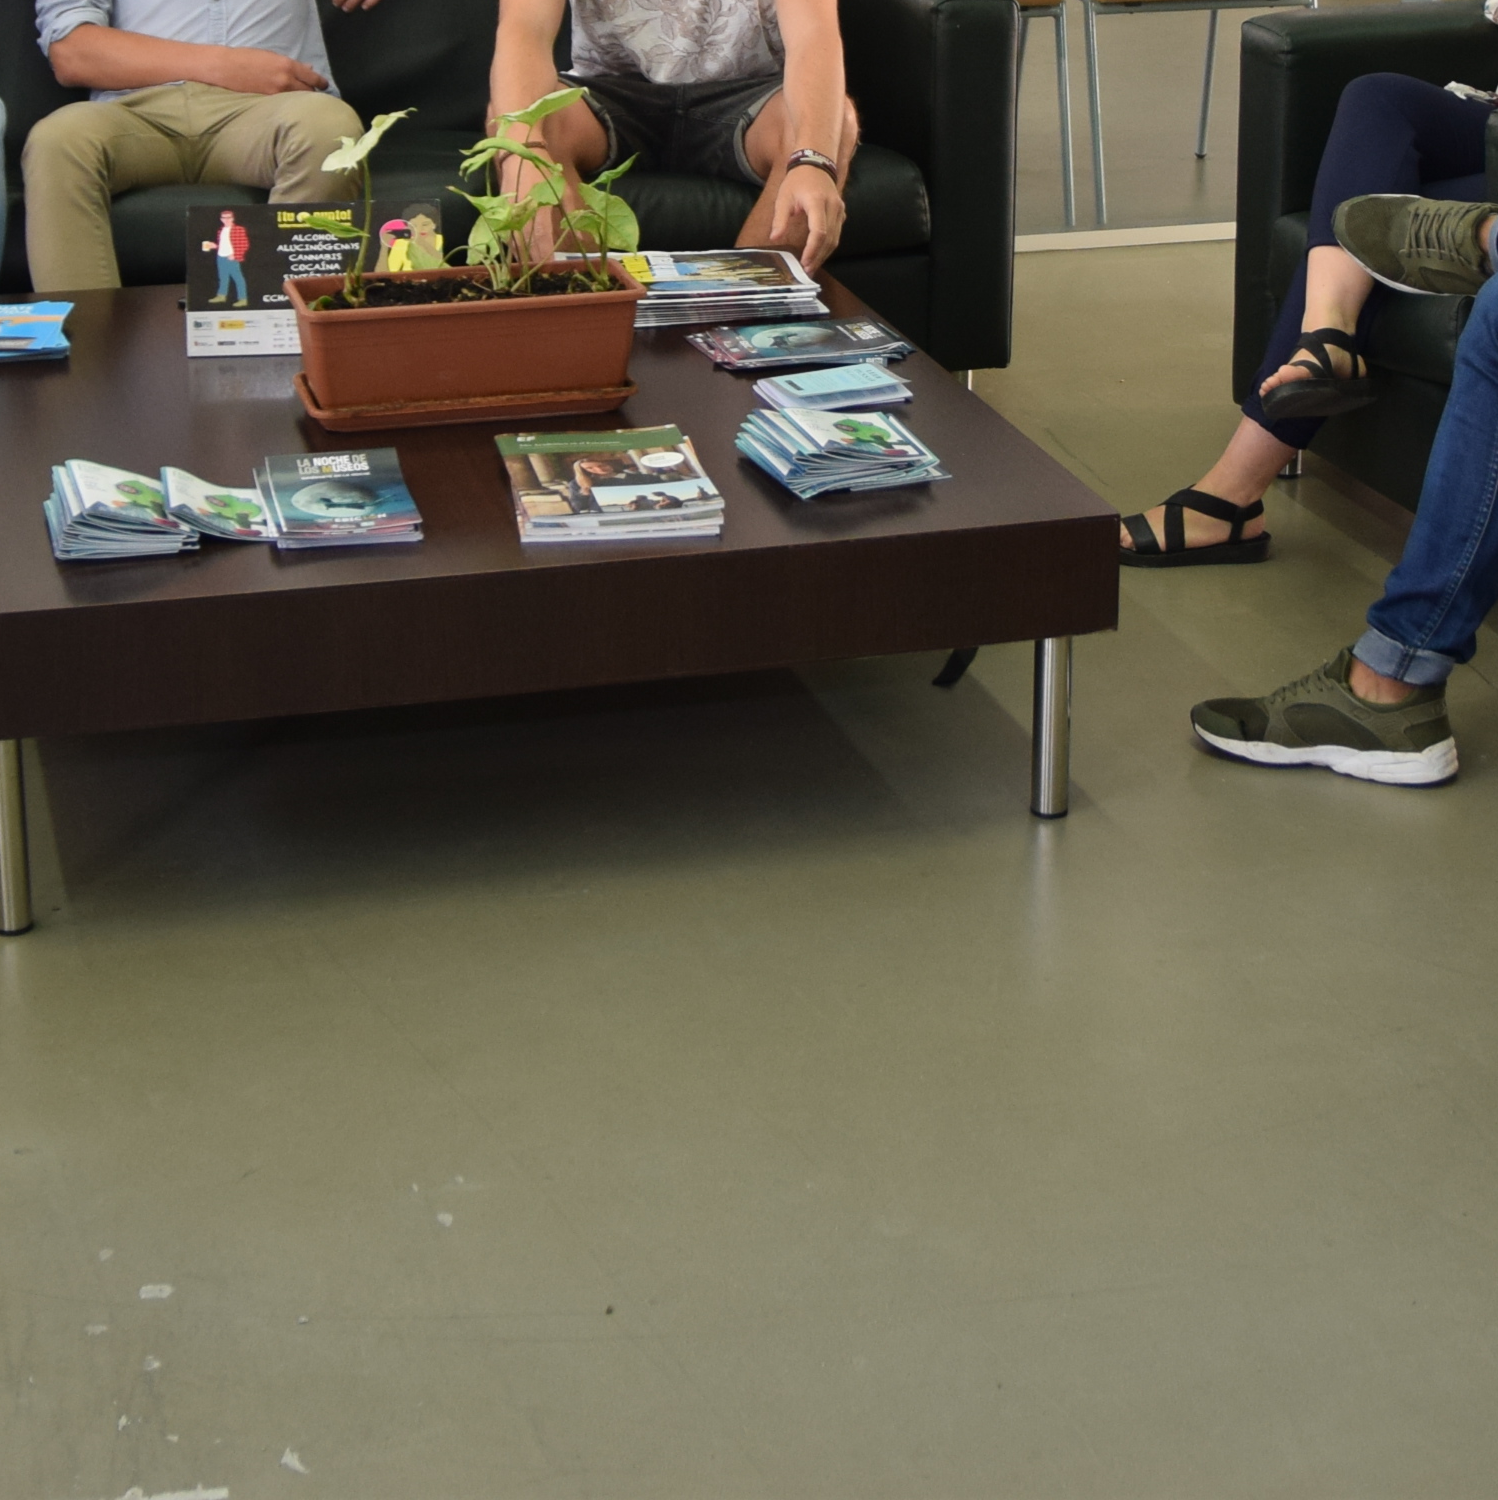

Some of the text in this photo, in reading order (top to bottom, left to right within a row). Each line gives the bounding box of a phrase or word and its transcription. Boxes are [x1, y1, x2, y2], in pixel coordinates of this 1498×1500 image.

[291, 233, 339, 242] ALCOHOL
[288, 252, 343, 262] CANNABIS
[290, 261, 341, 271] COCAÍNA
[296, 453, 367, 468] LA NOCHE DE
[298, 461, 370, 475] LOS MUSEOS
